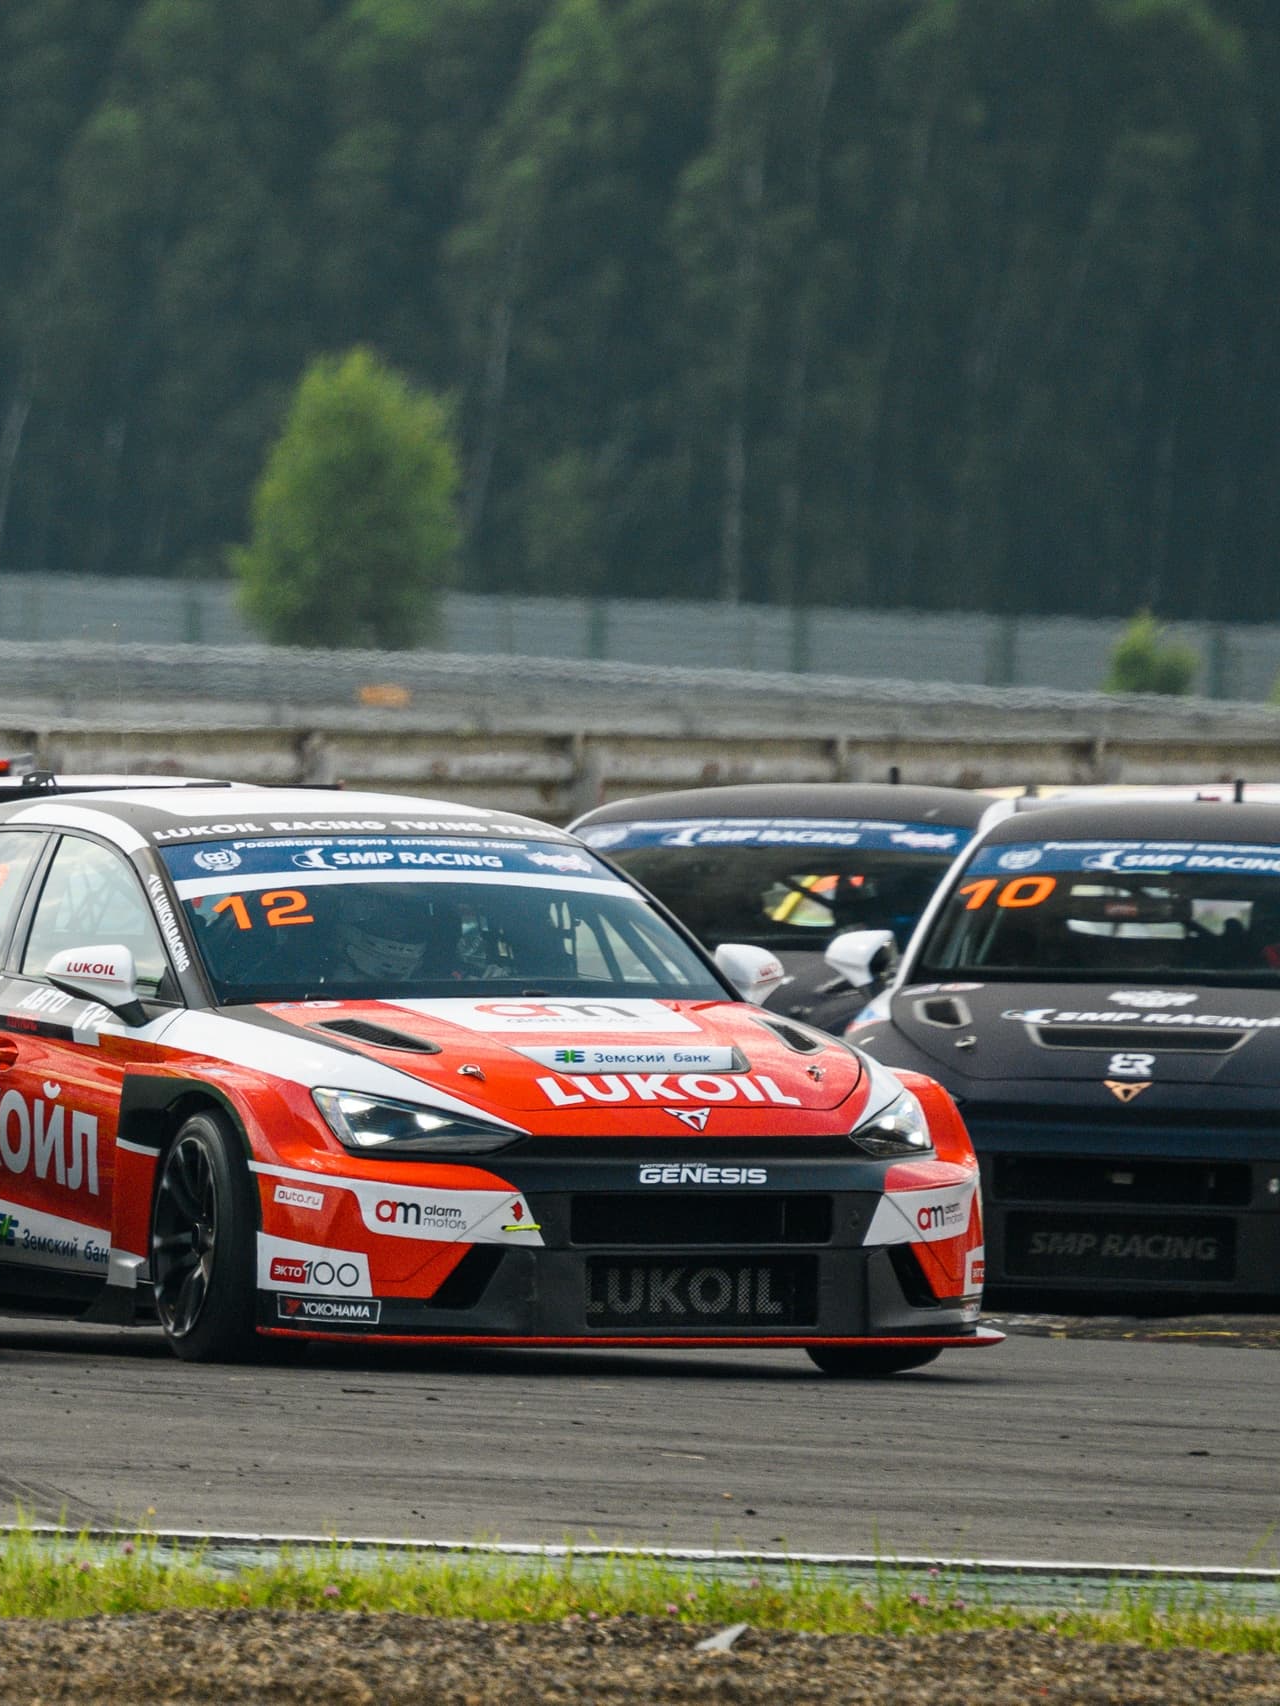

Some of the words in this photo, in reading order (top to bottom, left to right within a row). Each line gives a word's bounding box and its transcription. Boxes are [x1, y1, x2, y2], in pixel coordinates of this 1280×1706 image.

[152, 822, 264, 841] LUKOIL
[269, 820, 387, 832] RACING
[391, 820, 489, 833] TWINS
[758, 830, 863, 845] RACING
[333, 851, 394, 865] SMP
[398, 852, 504, 868] RACING
[1121, 854, 1185, 867] SMP
[959, 875, 1057, 910] 10
[212, 889, 315, 930] 12
[66, 961, 116, 976] LUKOIL
[473, 1003, 640, 1018] am
[1054, 1011, 1142, 1022] SMP
[593, 1051, 666, 1064] Земский
[673, 1051, 712, 1064] банк
[536, 1074, 802, 1106] LUKOIL
[639, 1167, 767, 1184] GENESIS
[278, 1189, 320, 1206] auto.ru
[375, 1199, 421, 1225] am
[424, 1205, 462, 1217] alarm
[917, 1205, 944, 1231] am
[423, 1217, 467, 1230] motors
[22, 1228, 79, 1259] Земский
[84, 1239, 110, 1264] бан
[1028, 1231, 1096, 1257] SMP
[1100, 1233, 1219, 1262] RACING
[303, 1261, 360, 1287] 100
[585, 1267, 784, 1315] LUKOIL
[302, 1301, 371, 1318] YOKOHAMA
